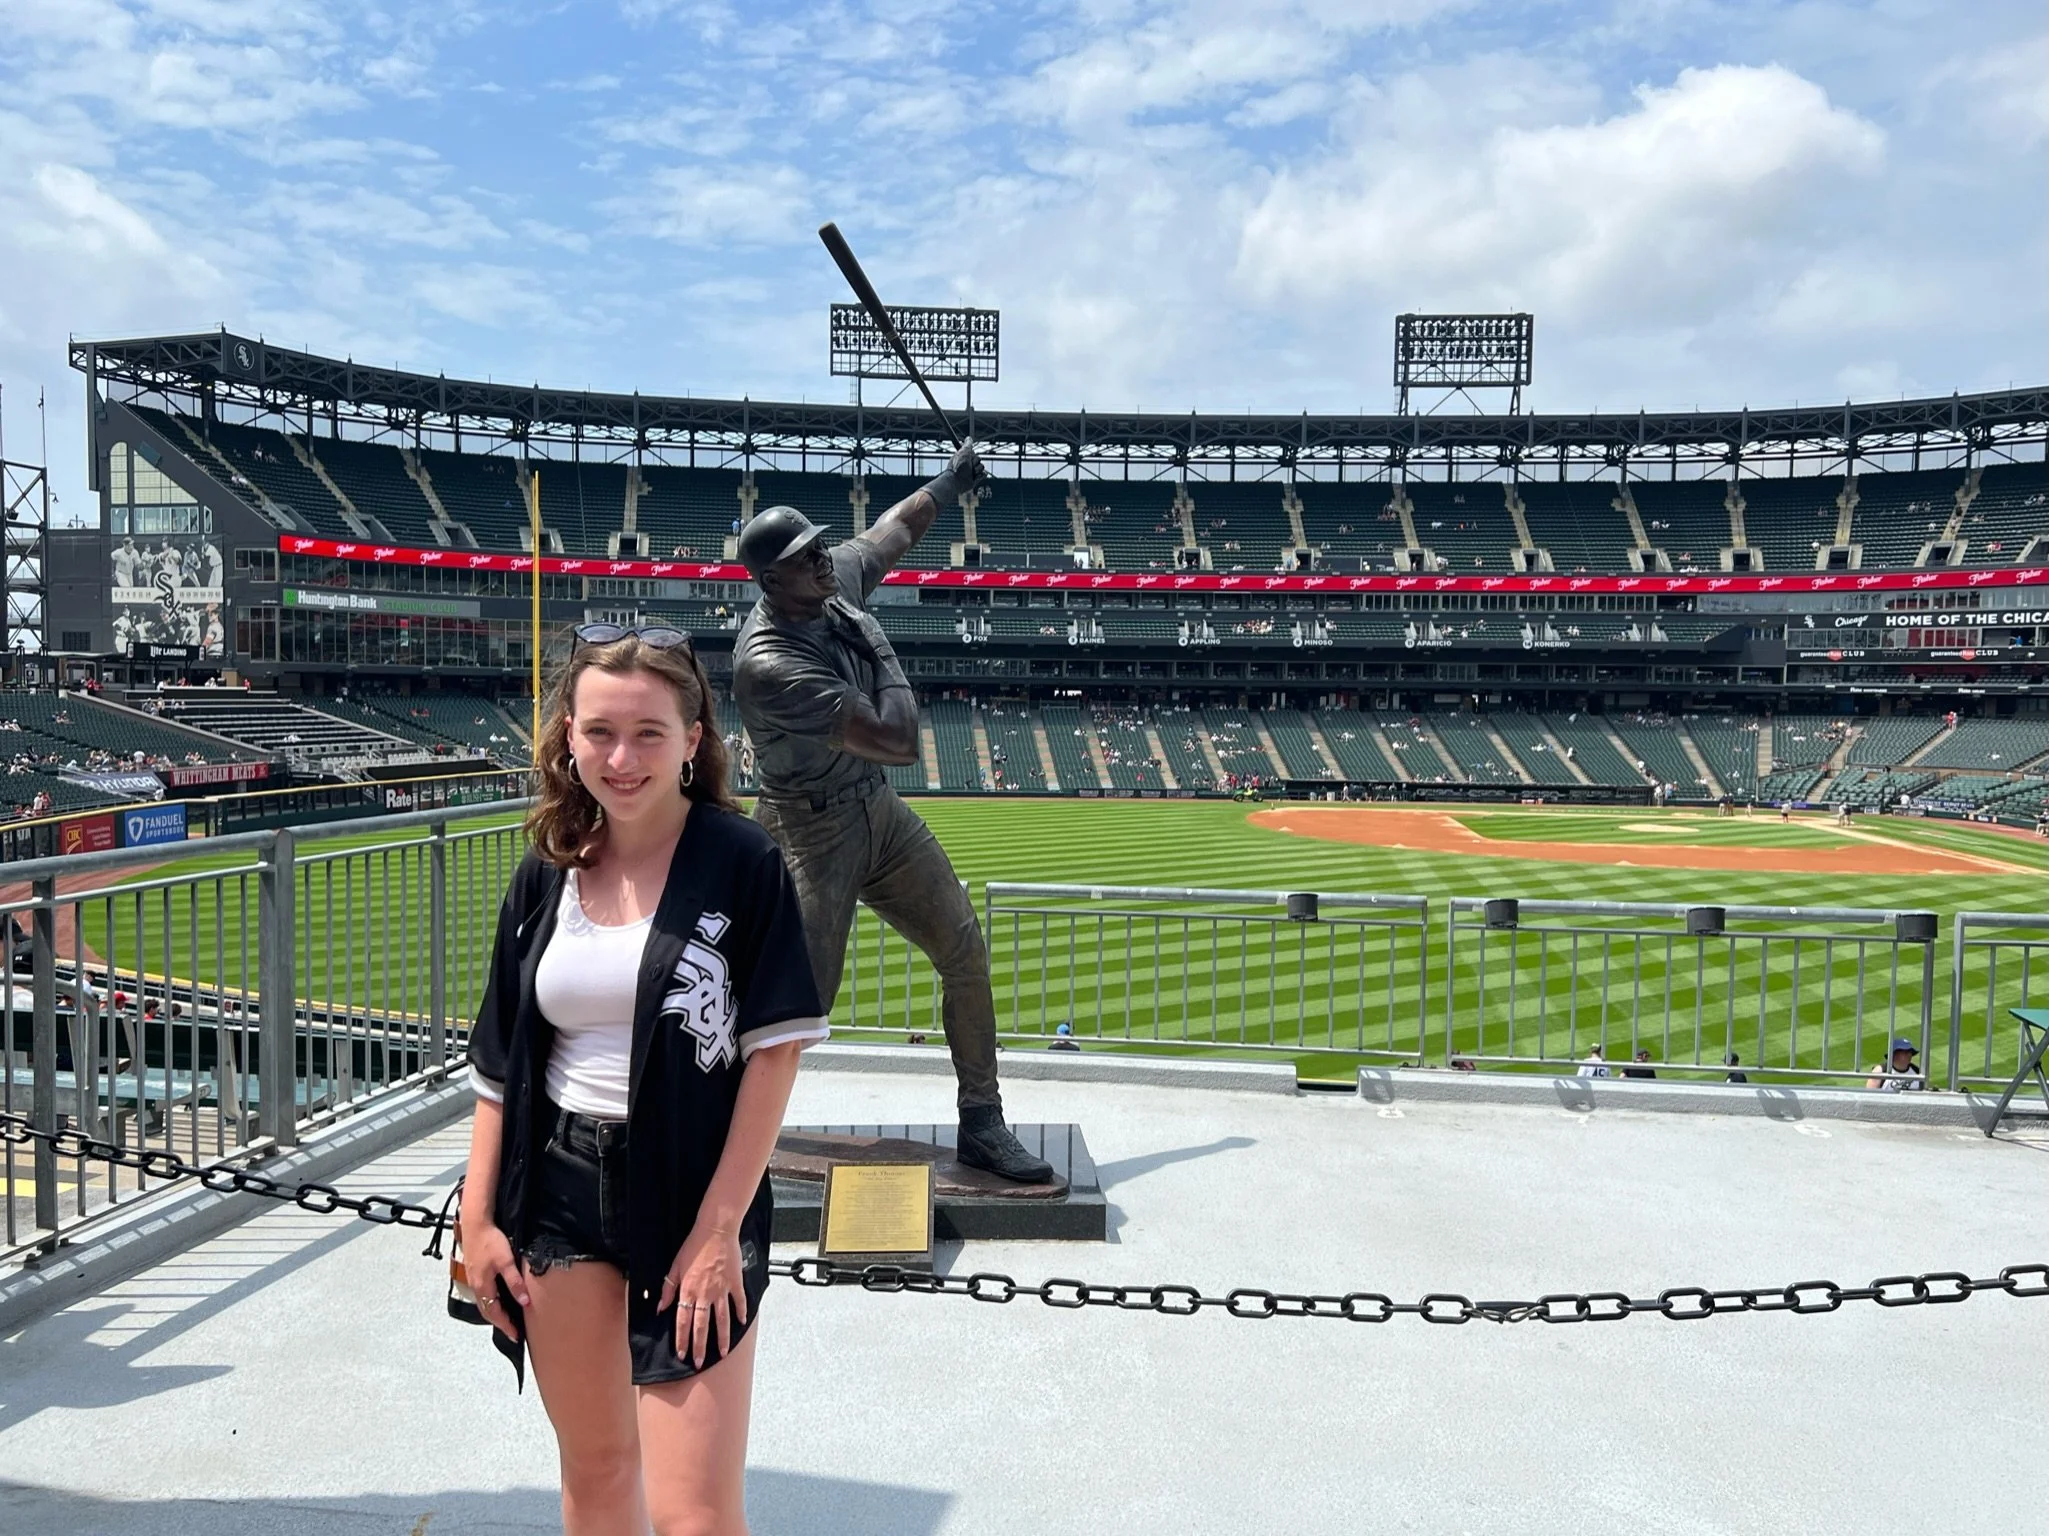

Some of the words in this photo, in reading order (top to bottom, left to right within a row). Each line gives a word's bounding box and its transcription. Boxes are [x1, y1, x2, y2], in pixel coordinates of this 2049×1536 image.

[298, 590, 349, 610] Huntington
[350, 594, 377, 609] Bank
[384, 600, 427, 611] STADIUM
[1834, 614, 1869, 628] Chicago
[1885, 615, 1933, 627] HOME
[1938, 614, 1961, 625] OF
[1965, 613, 1998, 625] THE
[1976, 649, 1999, 657] CLUB
[100, 774, 158, 791] HYUNDAI
[173, 767, 229, 785] WHITTINGHAM
[232, 765, 256, 780] MEATS
[386, 788, 412, 808] Rate
[145, 813, 184, 829] FANDUEL
[145, 826, 184, 839] SPORTSBOOK
